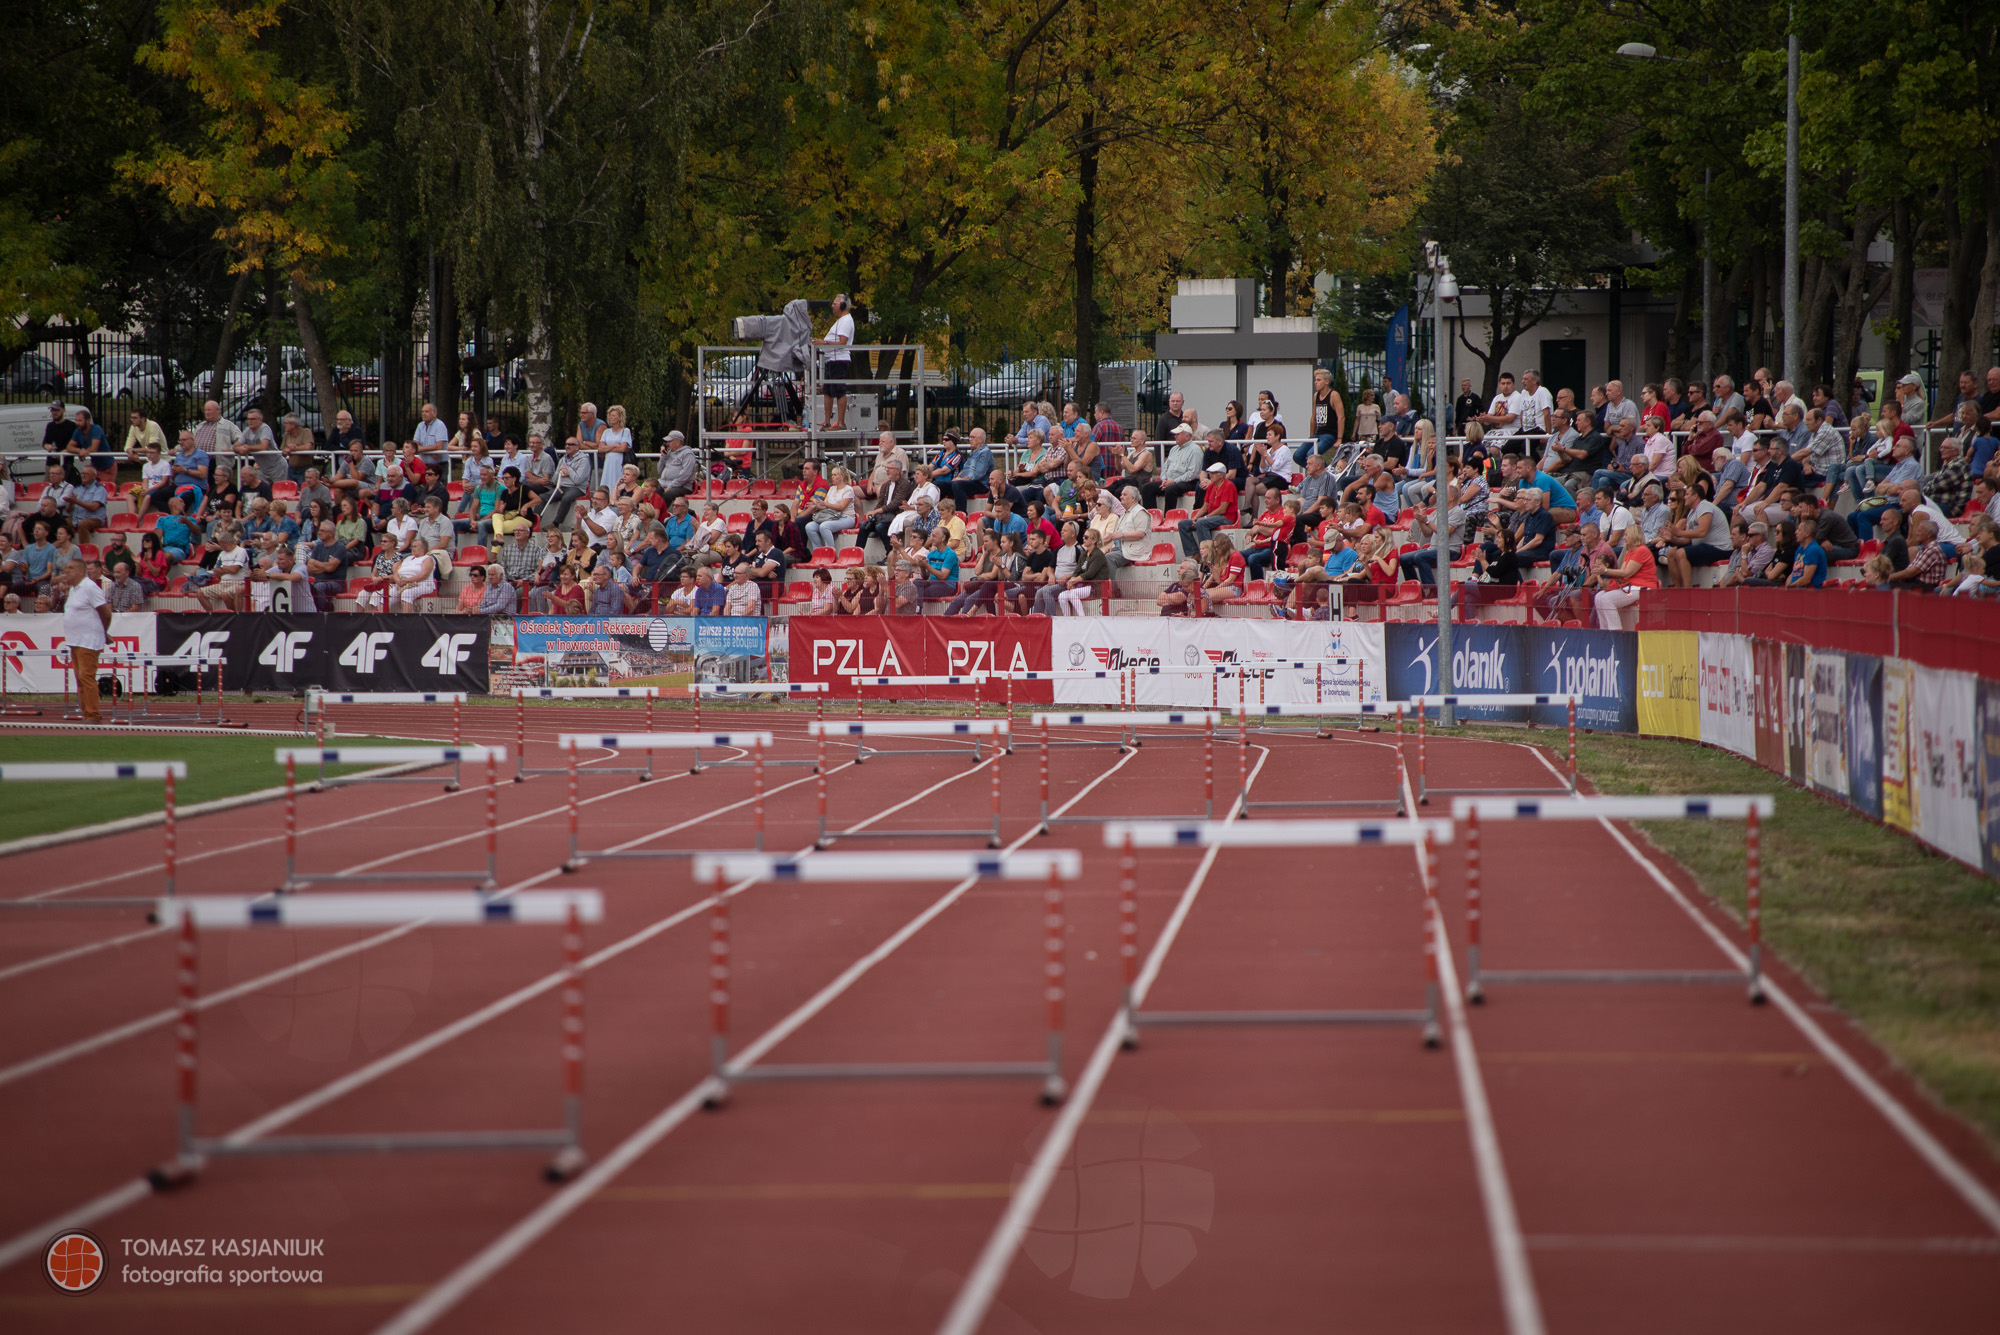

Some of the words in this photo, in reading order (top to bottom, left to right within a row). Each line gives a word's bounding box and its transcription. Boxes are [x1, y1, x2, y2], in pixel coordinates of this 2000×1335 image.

[1162, 567, 1170, 578] 4
[272, 587, 289, 613] G
[427, 601, 434, 613] 3
[1331, 593, 1341, 620] H
[519, 620, 561, 634] Ośrodek
[562, 621, 595, 637] Sportu
[596, 621, 600, 634] i
[602, 621, 647, 637] Rekreacji
[698, 625, 722, 636] zawsze
[723, 626, 731, 636] ze
[732, 625, 759, 638] sportem
[258, 631, 314, 673] 4F
[338, 631, 395, 674] 4F
[420, 633, 477, 675] 4F
[546, 640, 556, 651] w
[557, 638, 620, 652] Inowrocławiu
[813, 639, 902, 675] PZLA
[948, 640, 1029, 678] PZLA
[1452, 637, 1506, 690] olanik
[1566, 643, 1621, 702] polanik
